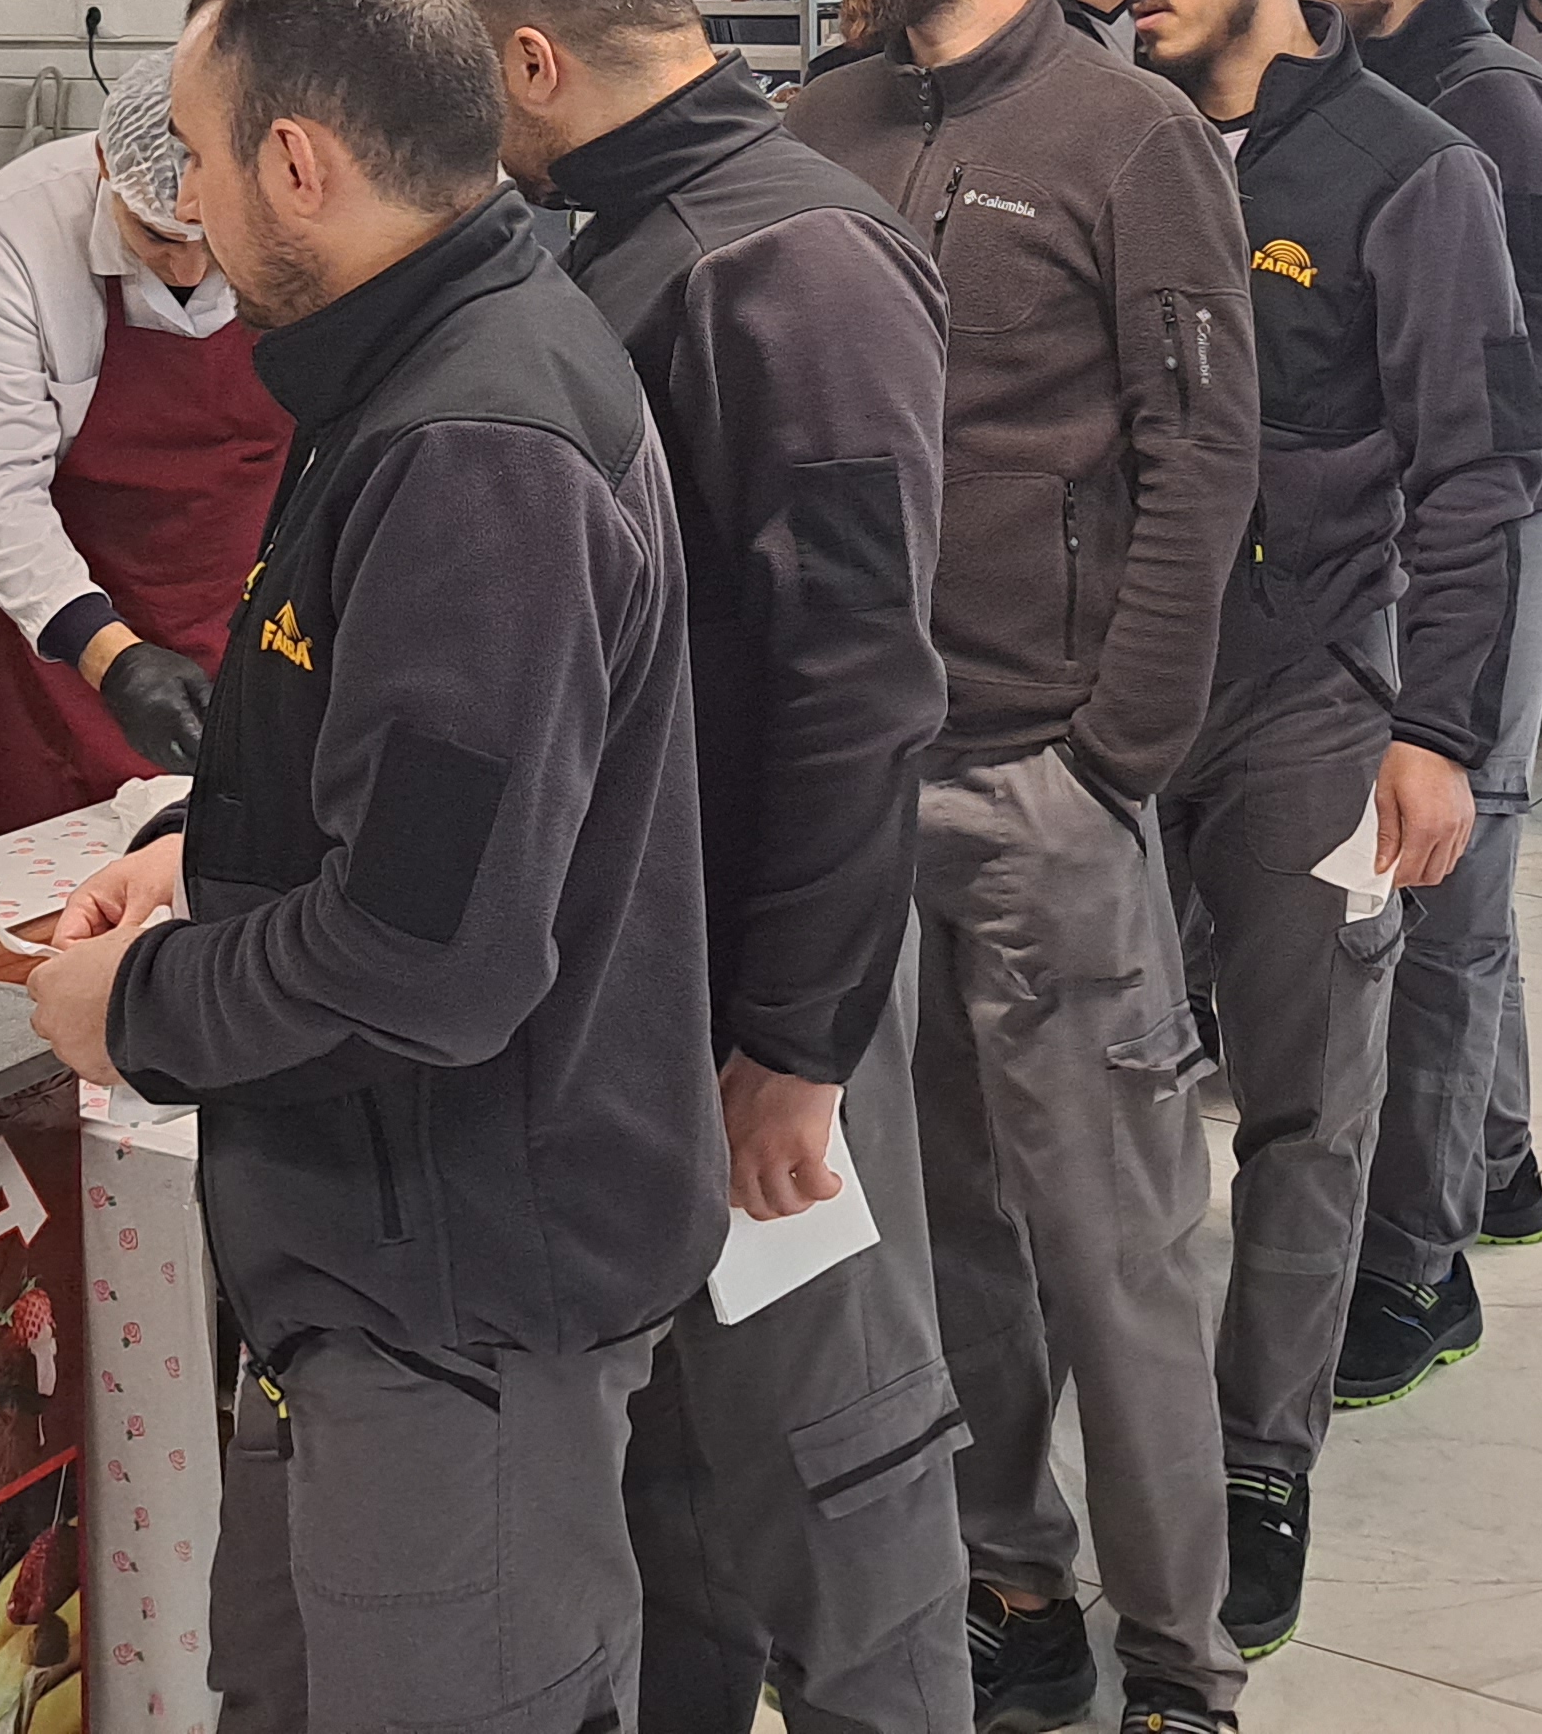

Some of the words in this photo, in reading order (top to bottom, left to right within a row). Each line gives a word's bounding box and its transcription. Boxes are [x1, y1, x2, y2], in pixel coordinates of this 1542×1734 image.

[977, 193, 1036, 218] Columbia
[1250, 250, 1312, 288] FARBA
[1196, 322, 1212, 385] Columbia
